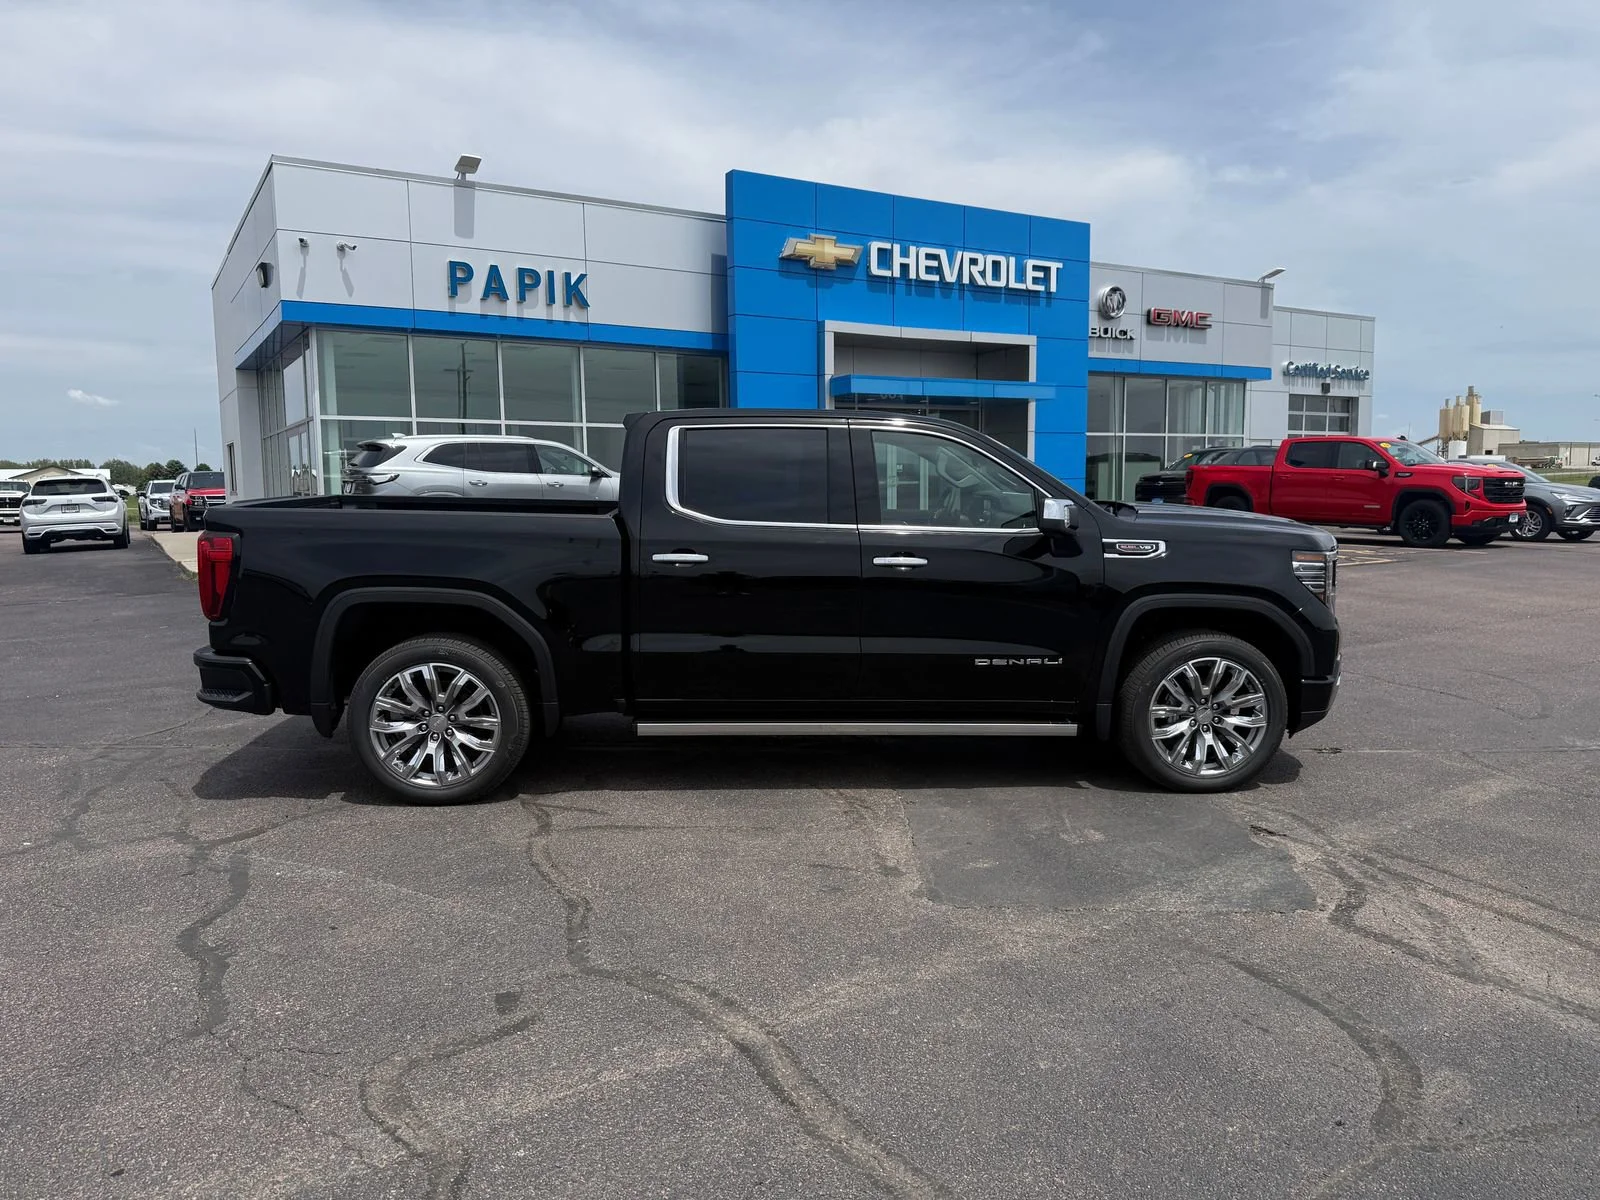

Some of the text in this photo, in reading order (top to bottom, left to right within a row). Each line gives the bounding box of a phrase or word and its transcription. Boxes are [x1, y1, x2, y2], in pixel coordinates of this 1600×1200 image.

[867, 241, 1063, 293] CHEVROLET
[447, 260, 590, 308] PAPIK
[1149, 307, 1212, 329] GMC
[1089, 326, 1136, 340] BUICK
[1284, 361, 1369, 381] Certified Service
[974, 658, 1063, 666] DENALI
